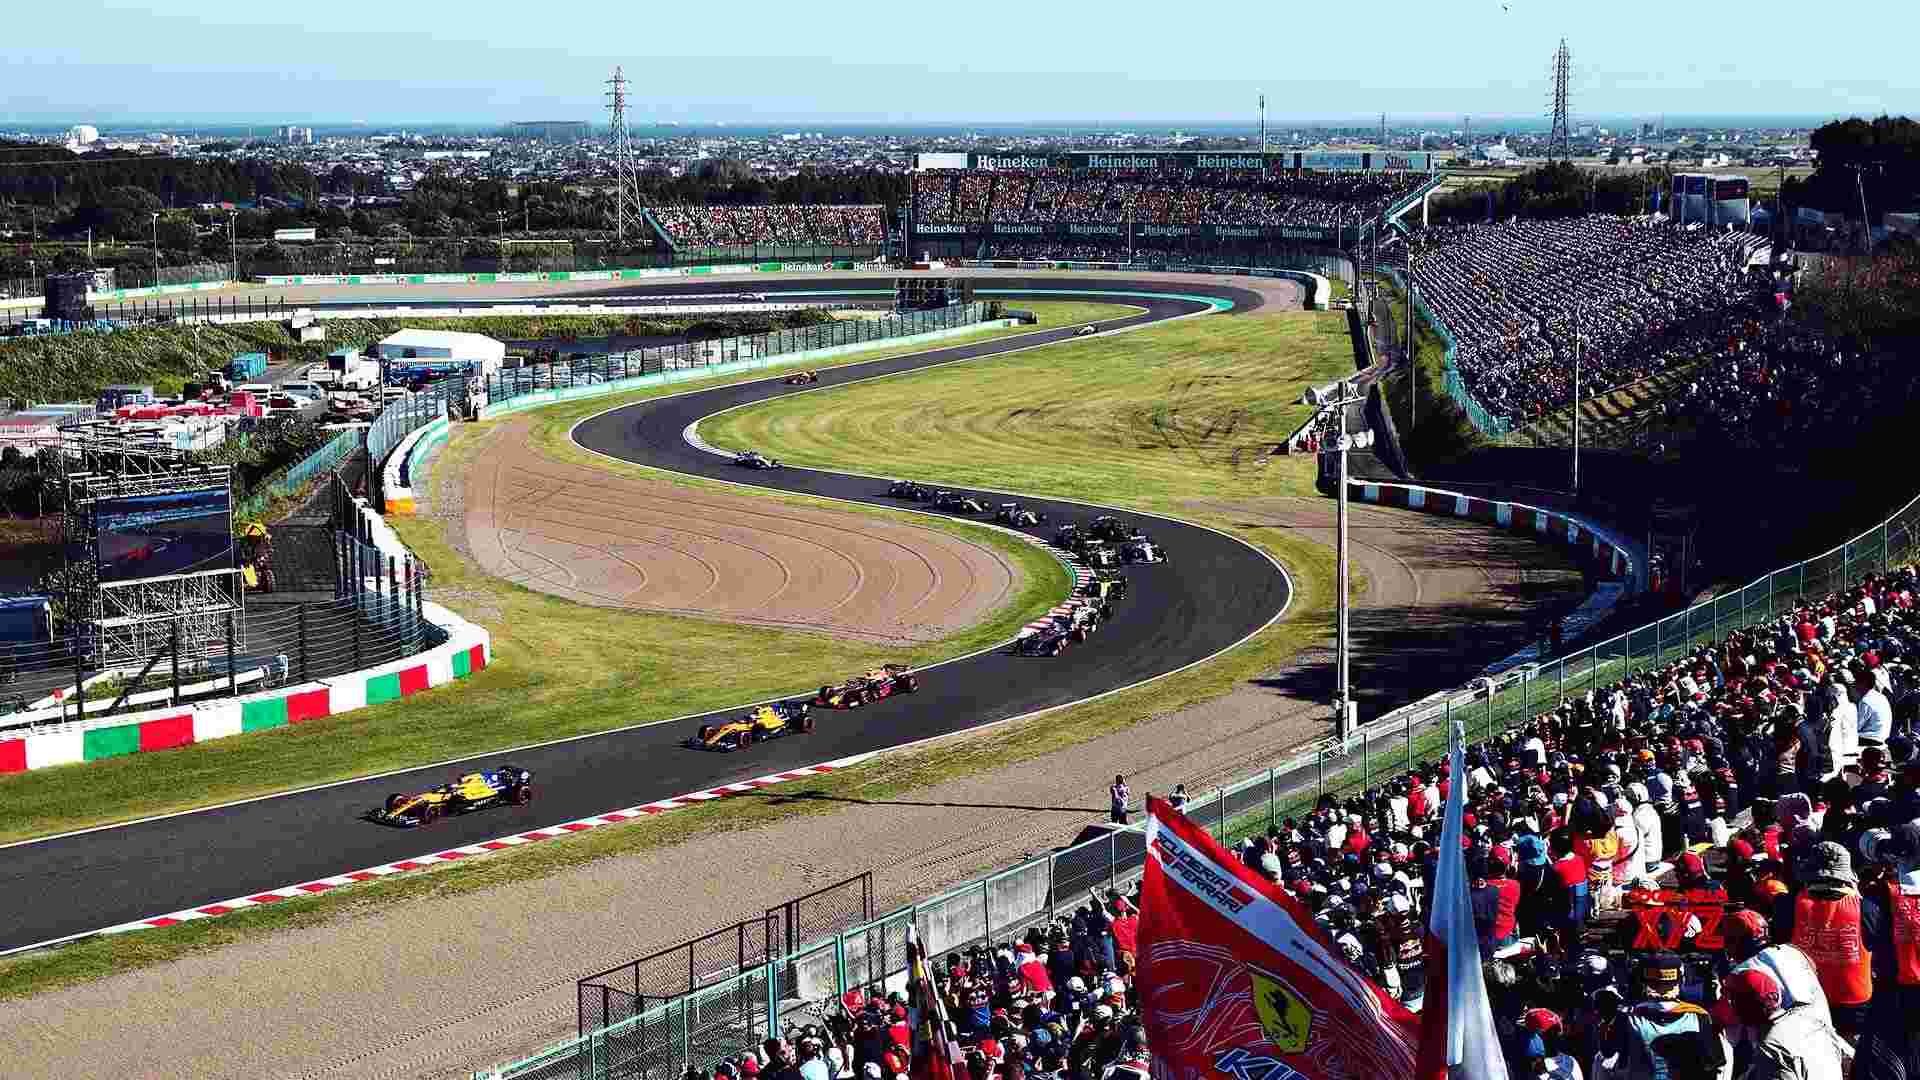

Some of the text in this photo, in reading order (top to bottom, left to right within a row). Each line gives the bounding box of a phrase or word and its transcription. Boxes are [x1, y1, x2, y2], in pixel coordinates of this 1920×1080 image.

[977, 155, 1048, 169] Heineken
[1088, 155, 1157, 169] Heineken
[1197, 155, 1263, 169] Heineken
[916, 223, 966, 234] Heineken
[993, 223, 1042, 234] Heineken
[782, 262, 823, 272] Heineken
[1171, 862, 1243, 914] FERRARI
